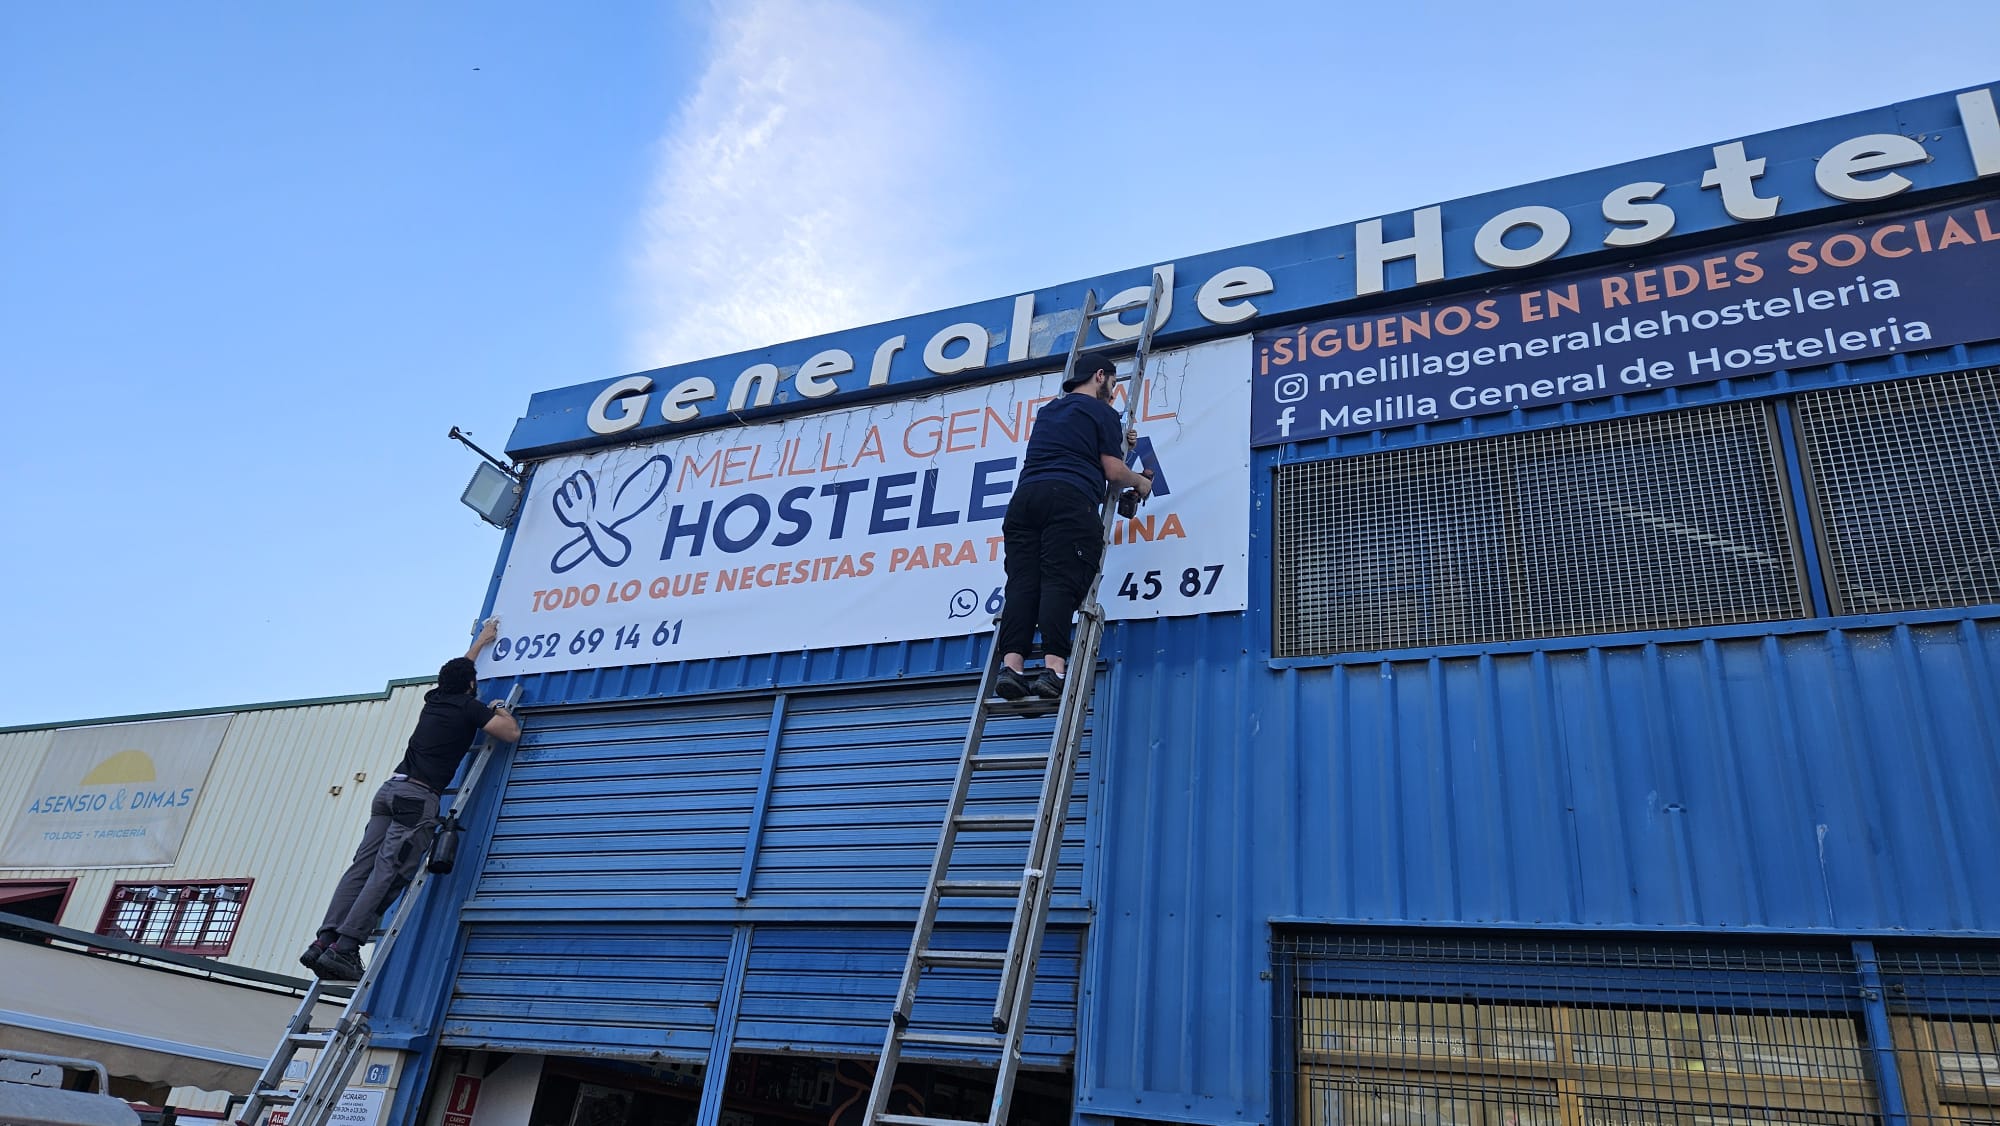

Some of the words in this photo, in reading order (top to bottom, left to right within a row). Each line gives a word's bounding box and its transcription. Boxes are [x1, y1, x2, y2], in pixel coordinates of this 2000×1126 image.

[587, 294, 1036, 434] General
[1098, 264, 1274, 341] de
[1355, 88, 2000, 296] Hostel
[1261, 300, 1500, 376] ¡SÍGUENOS
[1520, 284, 1580, 323] EN
[1601, 251, 1765, 309] REDES
[1319, 275, 1901, 391] melillageneraldehosteleria
[1320, 394, 1437, 431] Melilla
[1450, 365, 1606, 411] General
[1620, 358, 1675, 386] de
[1689, 317, 1932, 375] Hosteleria
[676, 425, 886, 493] MELILLA
[660, 436, 1171, 560] HOSTELEA
[532, 583, 601, 613] TODO
[606, 580, 642, 604] LO
[649, 571, 706, 599] QUE
[715, 551, 877, 593] NECESITAS
[889, 539, 978, 574] PARA
[1117, 570, 1163, 601] 45
[1179, 564, 1225, 598] 87
[514, 633, 561, 661] 952
[568, 628, 605, 656] 69
[615, 623, 641, 651] 14
[652, 618, 683, 647] 61
[28, 793, 107, 814] ASENSIO
[109, 788, 128, 812] &
[130, 787, 194, 810] DIMAS
[43, 831, 82, 841] TOLDOS
[93, 825, 147, 840] TAPICERÍA
[343, 1093, 367, 1101] HORARIO
[370, 1066, 379, 1081] 6
